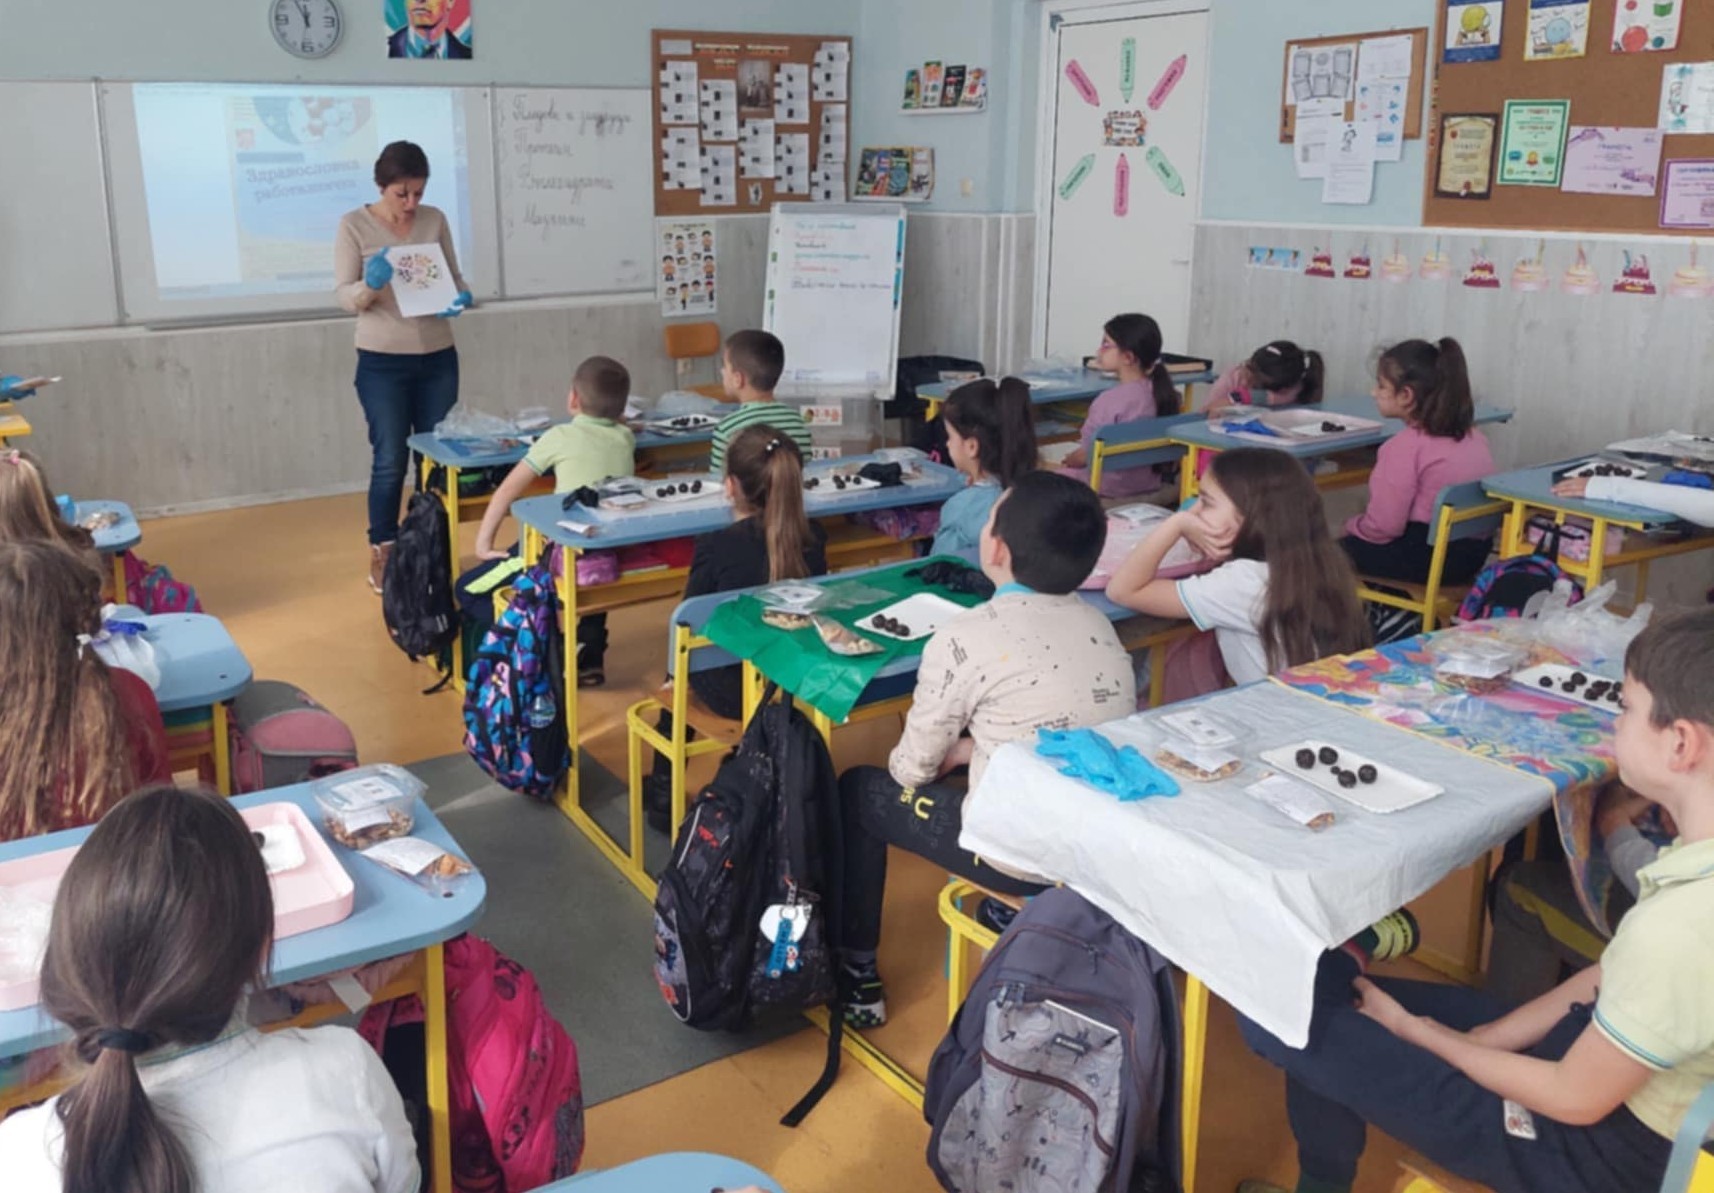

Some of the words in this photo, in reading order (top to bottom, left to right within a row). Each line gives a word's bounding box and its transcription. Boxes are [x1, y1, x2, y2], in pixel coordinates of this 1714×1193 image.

[275, 14, 289, 26] 9
[323, 16, 335, 28] 3
[302, 41, 314, 52] 6
